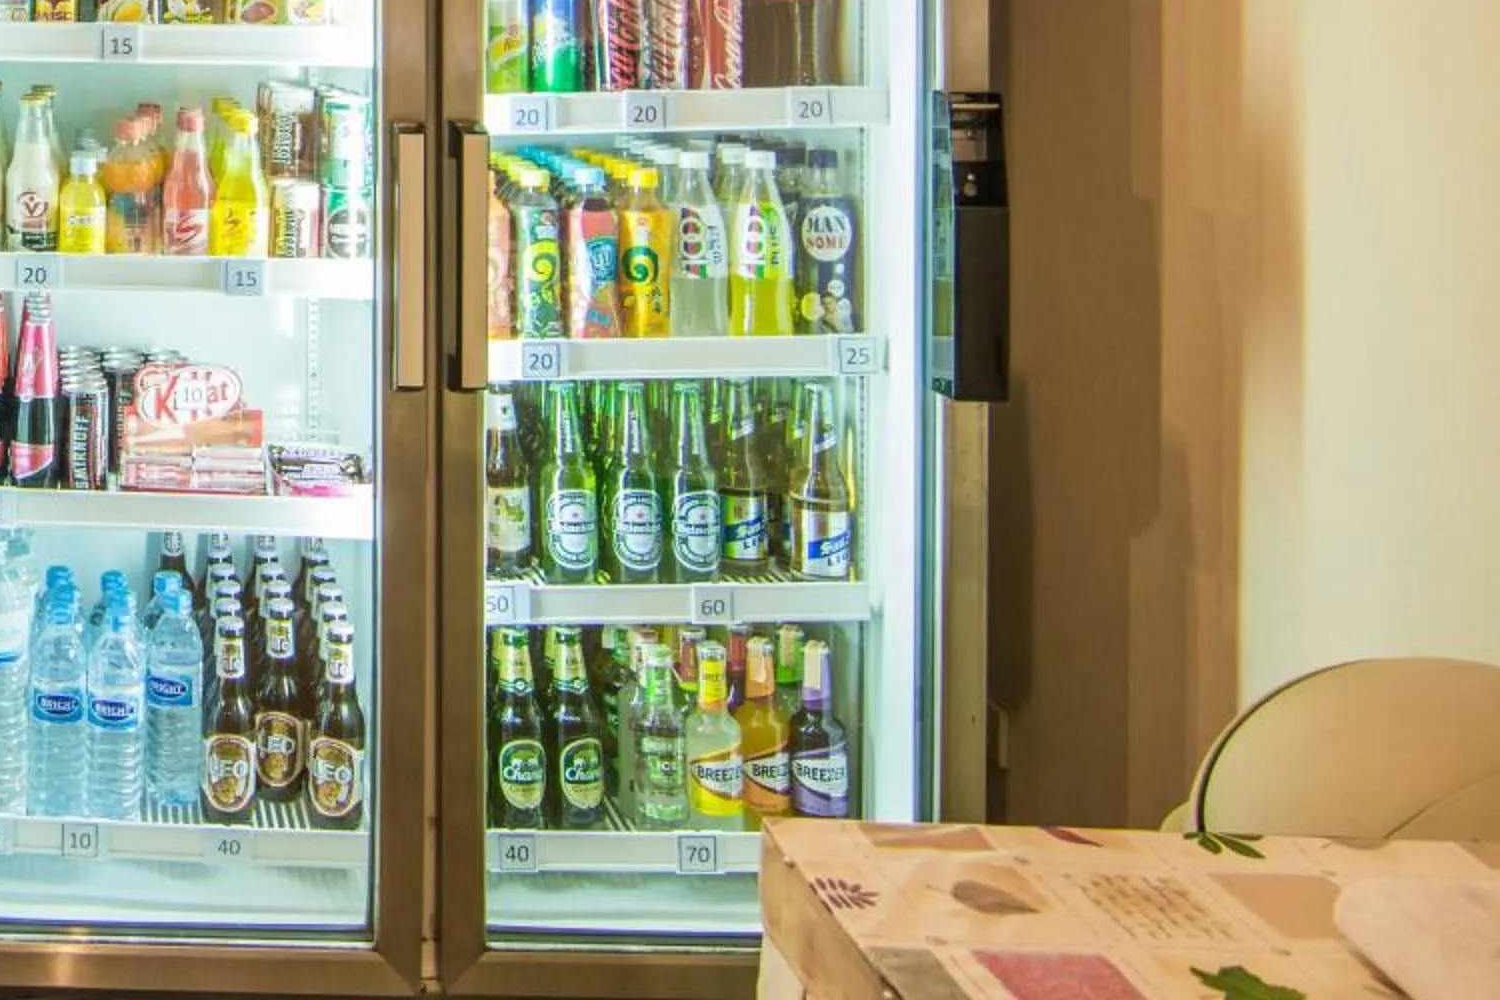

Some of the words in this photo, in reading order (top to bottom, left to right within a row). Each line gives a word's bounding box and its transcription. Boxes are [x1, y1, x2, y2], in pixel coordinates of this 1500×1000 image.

[110, 38, 134, 55] 15
[515, 109, 540, 126] 20
[632, 105, 657, 123] 20
[799, 100, 824, 119] 20
[806, 215, 846, 233] MAN
[806, 235, 846, 250] SOME
[23, 267, 48, 285] 20
[235, 271, 258, 288] 15
[528, 353, 553, 370] 20
[846, 348, 871, 366] 25
[701, 599, 725, 616] 60
[69, 833, 92, 850] 10
[216, 839, 242, 856] 40
[505, 845, 530, 861] 40
[686, 846, 711, 862] 70
